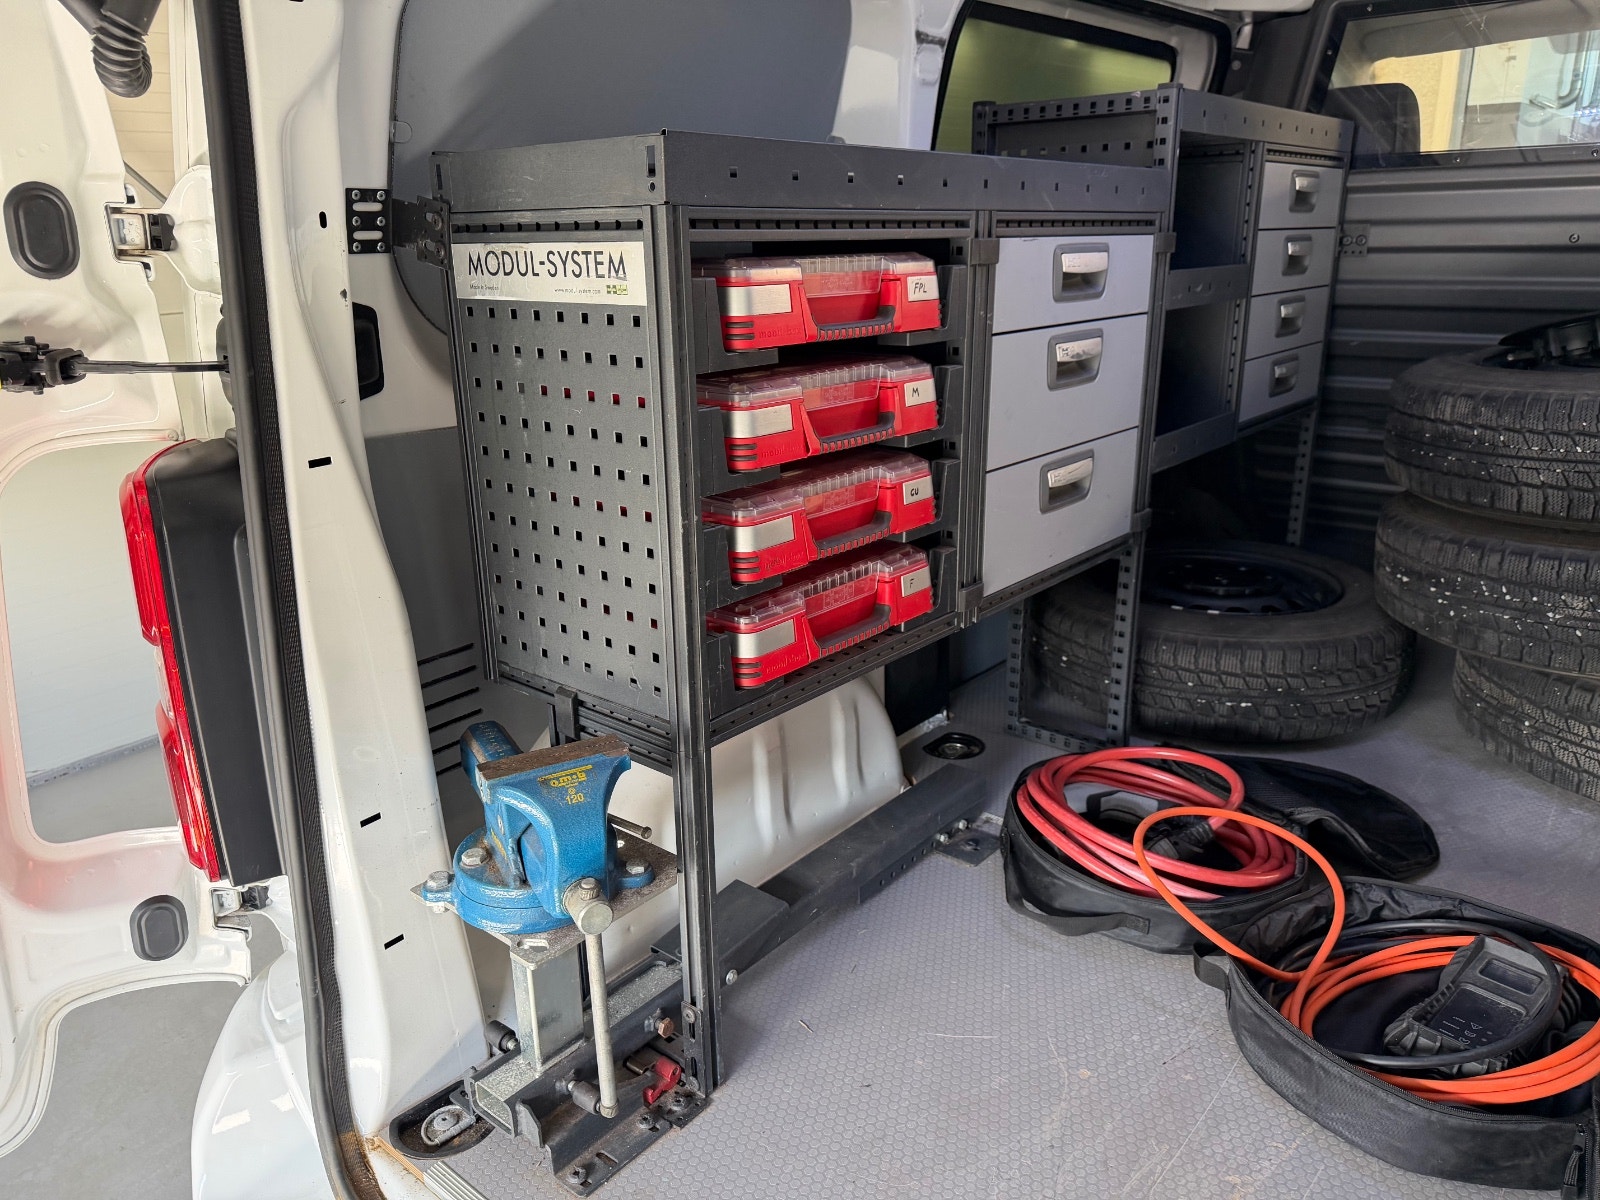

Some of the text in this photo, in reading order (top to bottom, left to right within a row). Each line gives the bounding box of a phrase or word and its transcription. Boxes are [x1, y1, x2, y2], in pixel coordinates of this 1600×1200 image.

[468, 250, 627, 280] MODUL-SYSTEM
[913, 282, 927, 295] FPL
[912, 387, 920, 398] M
[565, 793, 585, 805] 120
